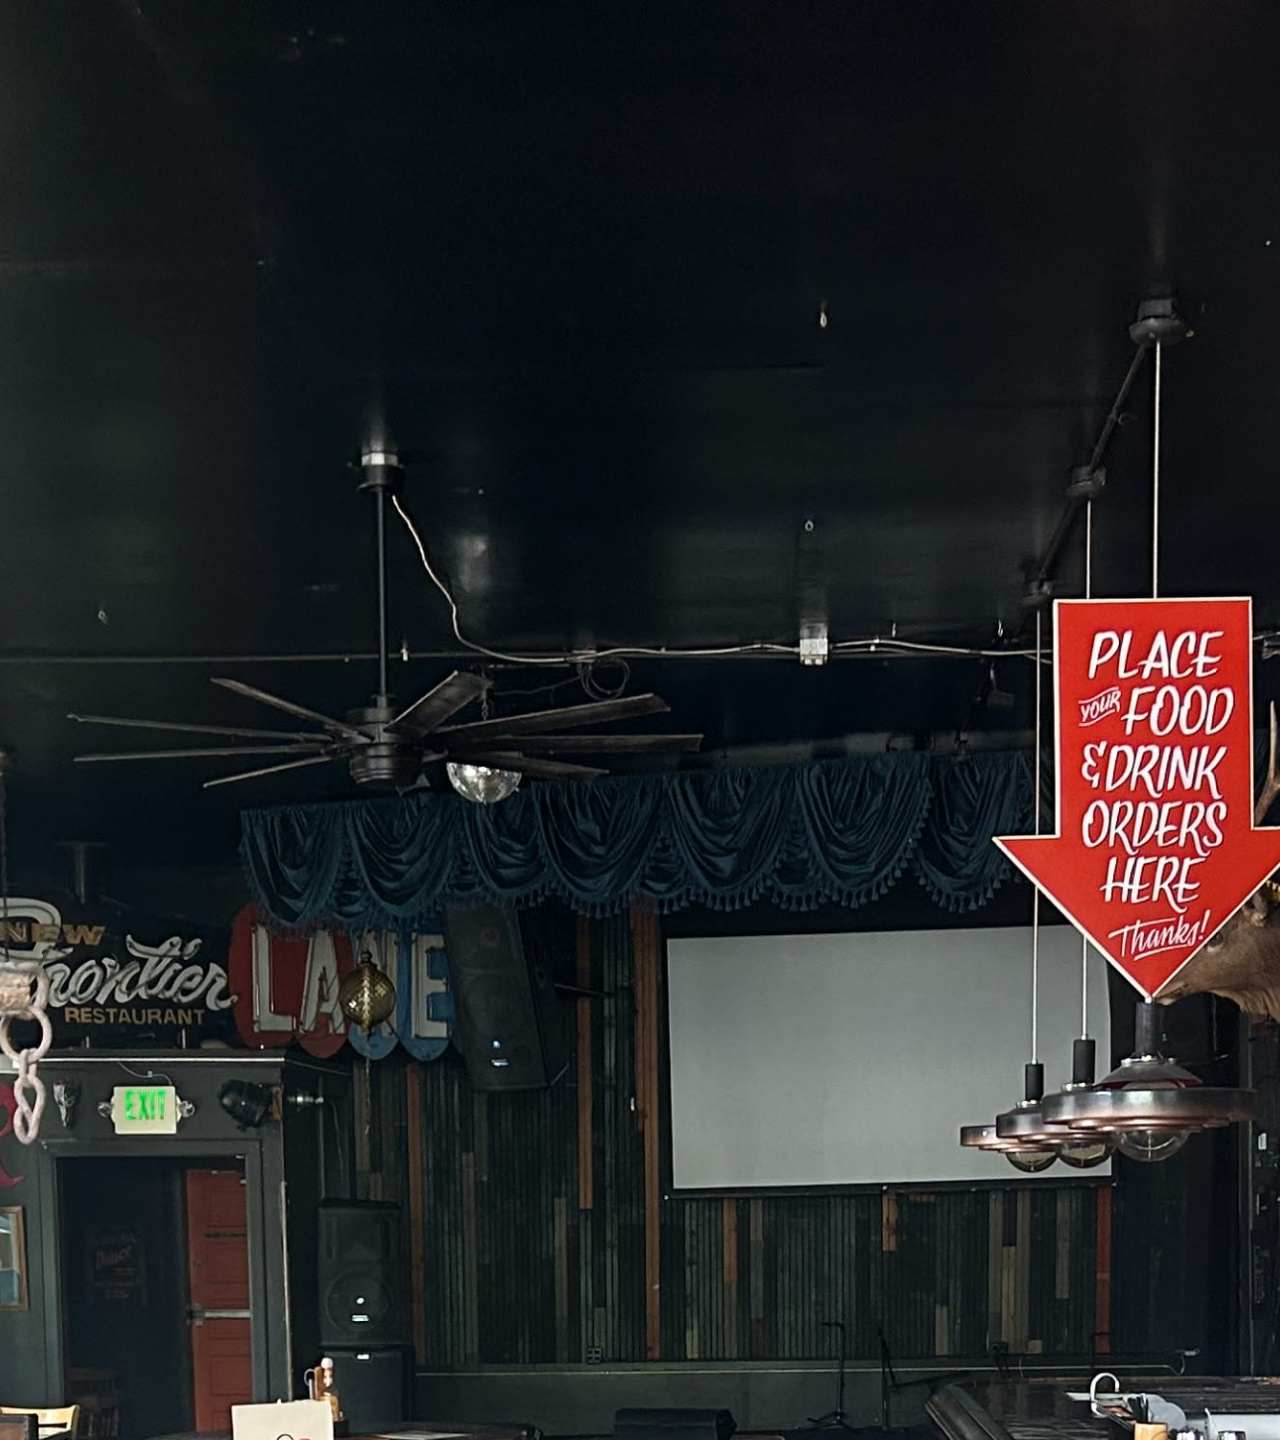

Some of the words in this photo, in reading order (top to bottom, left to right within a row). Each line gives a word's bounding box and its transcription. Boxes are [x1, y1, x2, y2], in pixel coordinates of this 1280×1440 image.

[1087, 630, 1225, 680] PLACE
[1080, 690, 1122, 722] YOUR
[1121, 685, 1235, 737] FOOD
[1081, 800, 1228, 857] ORDERS
[1099, 856, 1207, 914] HERE
[1107, 909, 1211, 957] Thanks!
[64, 1006, 206, 1026] RESTAURANT
[124, 1090, 167, 1121] EXIT
